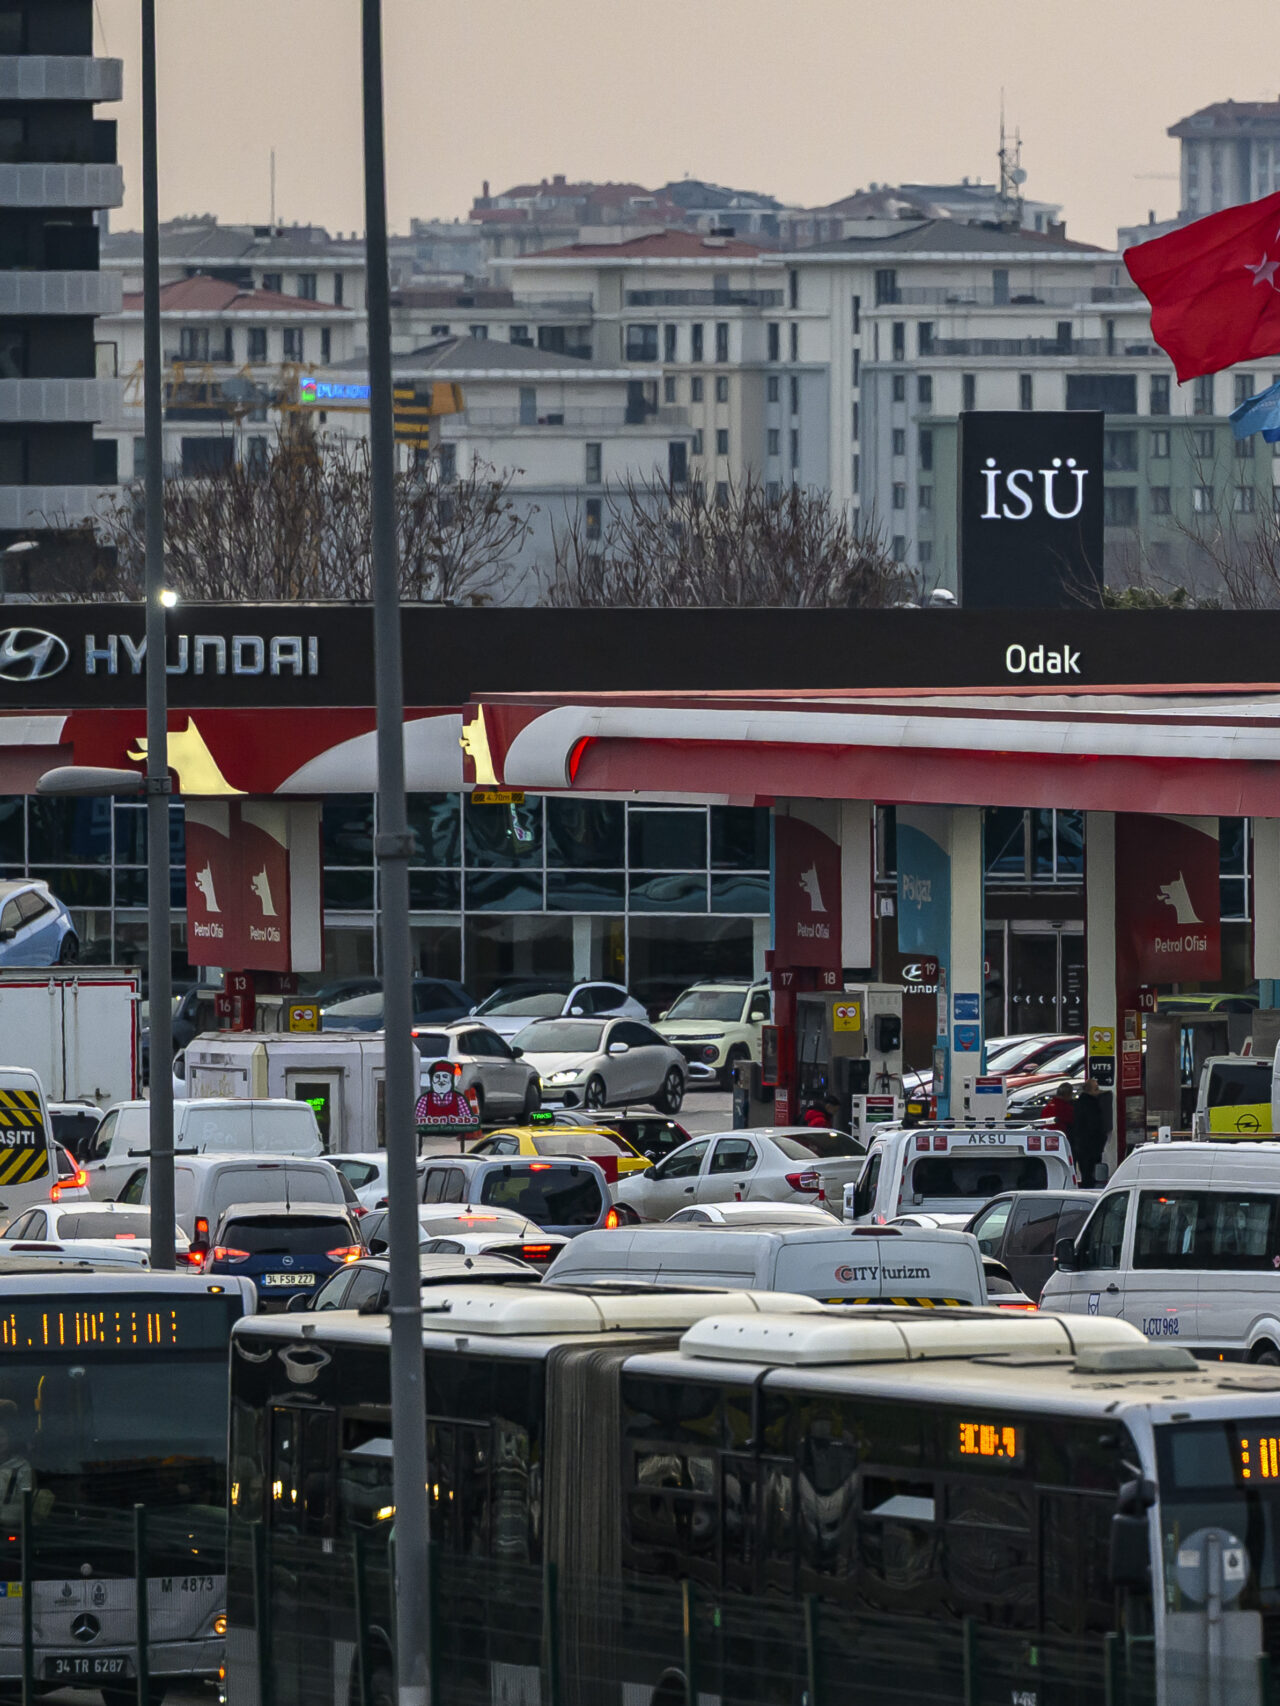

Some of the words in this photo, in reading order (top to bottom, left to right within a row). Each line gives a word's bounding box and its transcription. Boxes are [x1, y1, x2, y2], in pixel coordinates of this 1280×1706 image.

[980, 457, 1089, 520] İSÜ
[85, 634, 318, 675] HYUNDAI
[1005, 644, 1082, 675] Odak
[194, 922, 210, 937] Petrol
[211, 923, 224, 939] Ofisi
[250, 925, 266, 941] Petrol
[268, 927, 281, 942] Ofisi
[797, 922, 815, 938] Petrol
[816, 923, 830, 939] Ofisi
[1155, 937, 1183, 952] Petrol
[1184, 935, 1207, 951] Ofisi
[925, 963, 936, 976] 19
[234, 977, 246, 990] 13
[781, 972, 793, 985] 17
[824, 972, 836, 985] 18
[220, 999, 231, 1012] 16
[1139, 994, 1153, 1007] 10
[1091, 1063, 1111, 1071] UTTS
[449, 1113, 479, 1125] baba
[0, 1130, 35, 1148] AŞITI
[968, 1133, 1006, 1145] AKSU
[267, 1275, 277, 1284] 34
[298, 1275, 313, 1284] 227
[839, 1266, 879, 1281] CITY
[882, 1265, 931, 1279] turizm
[1143, 1318, 1163, 1336] LCU
[1163, 1318, 1179, 1335] 962
[162, 1579, 172, 1593] M
[181, 1577, 214, 1592] 4873
[56, 1660, 70, 1673] 34
[75, 1660, 89, 1673] TR
